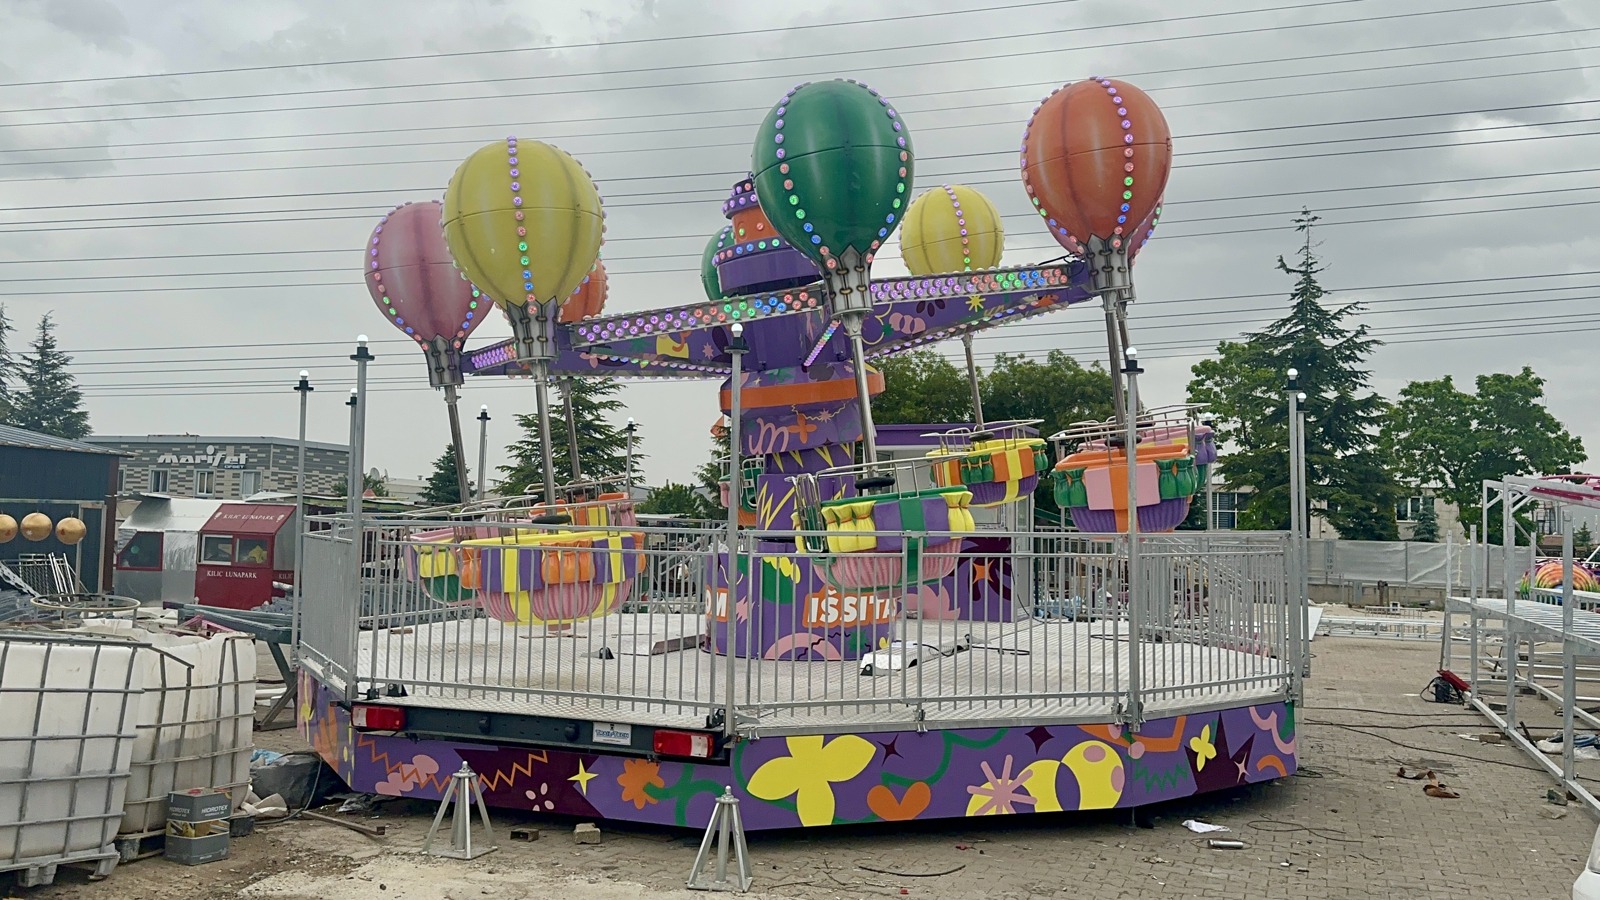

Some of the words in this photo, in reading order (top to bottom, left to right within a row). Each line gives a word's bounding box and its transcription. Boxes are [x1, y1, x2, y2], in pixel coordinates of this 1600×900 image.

[157, 445, 248, 467] marifet
[225, 571, 257, 579] LUNAPARK
[201, 804, 229, 814] HIDROTEX
